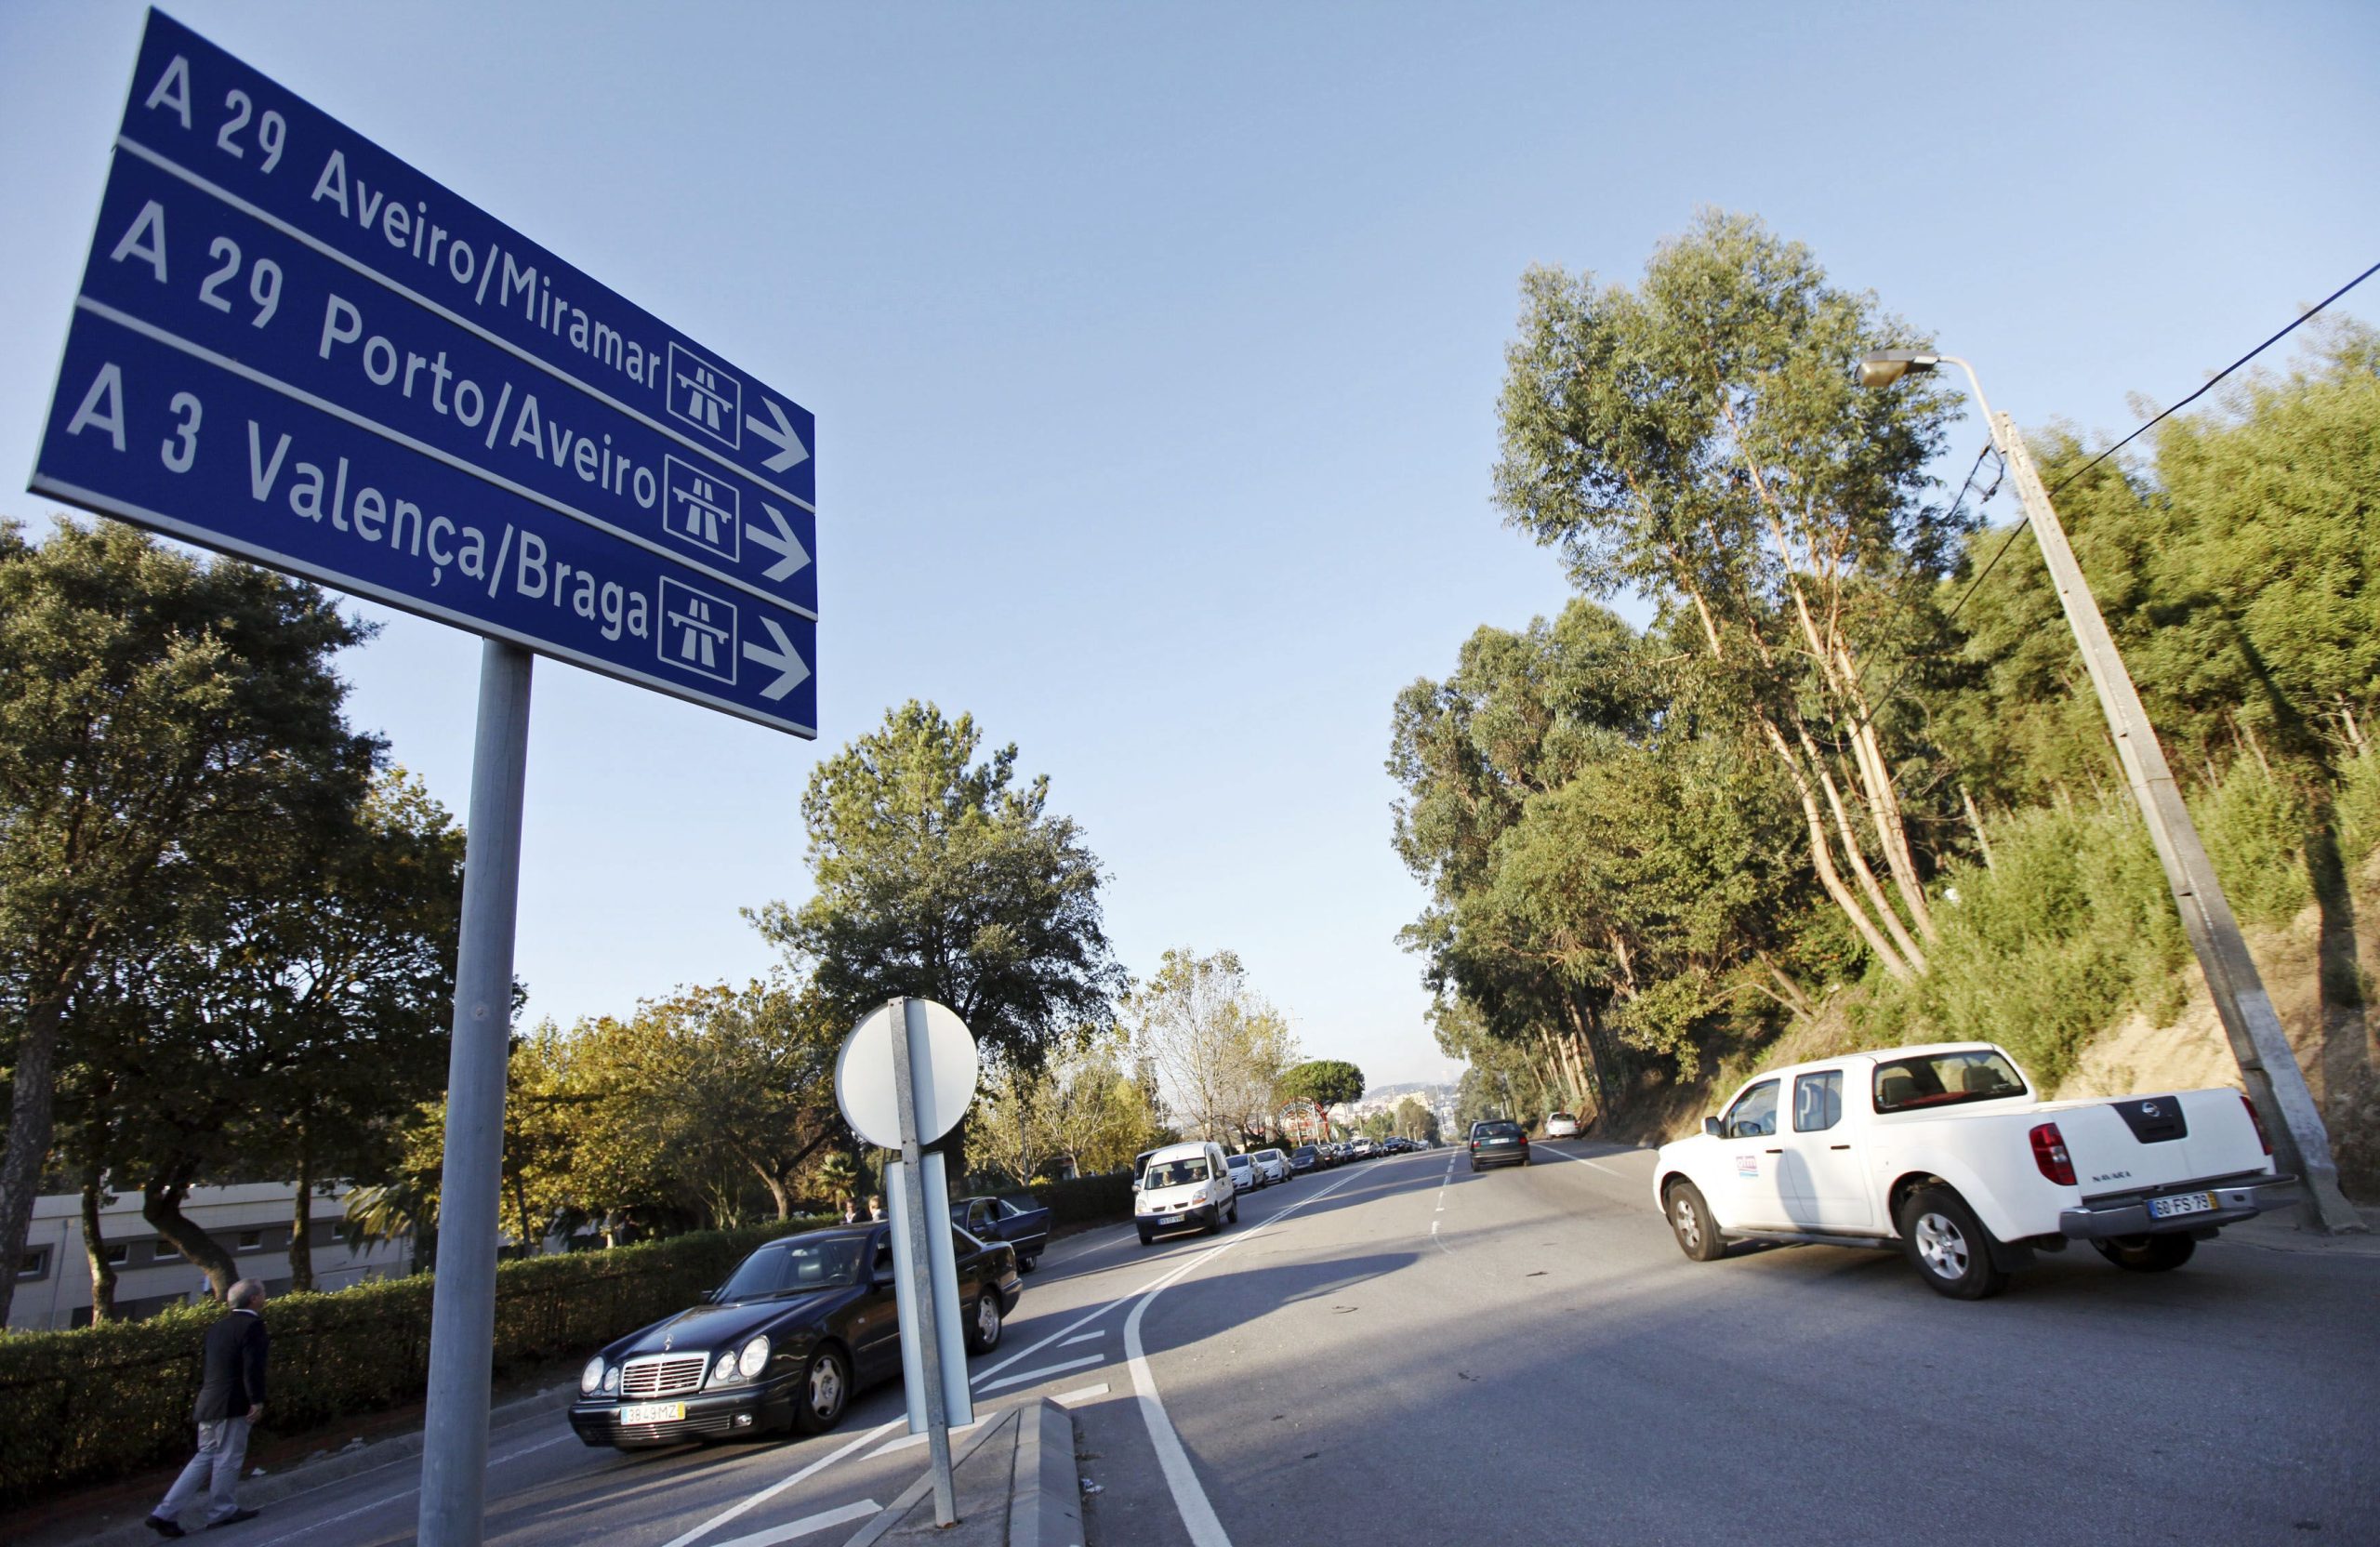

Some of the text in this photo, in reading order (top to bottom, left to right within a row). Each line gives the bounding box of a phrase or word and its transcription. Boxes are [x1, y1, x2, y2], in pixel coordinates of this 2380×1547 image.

[110, 200, 657, 510] A 29 Porto/Aveiro
[144, 54, 662, 390] A 29 Aveiro/Miramar
[66, 363, 649, 641] A 3 Valença/Braga
